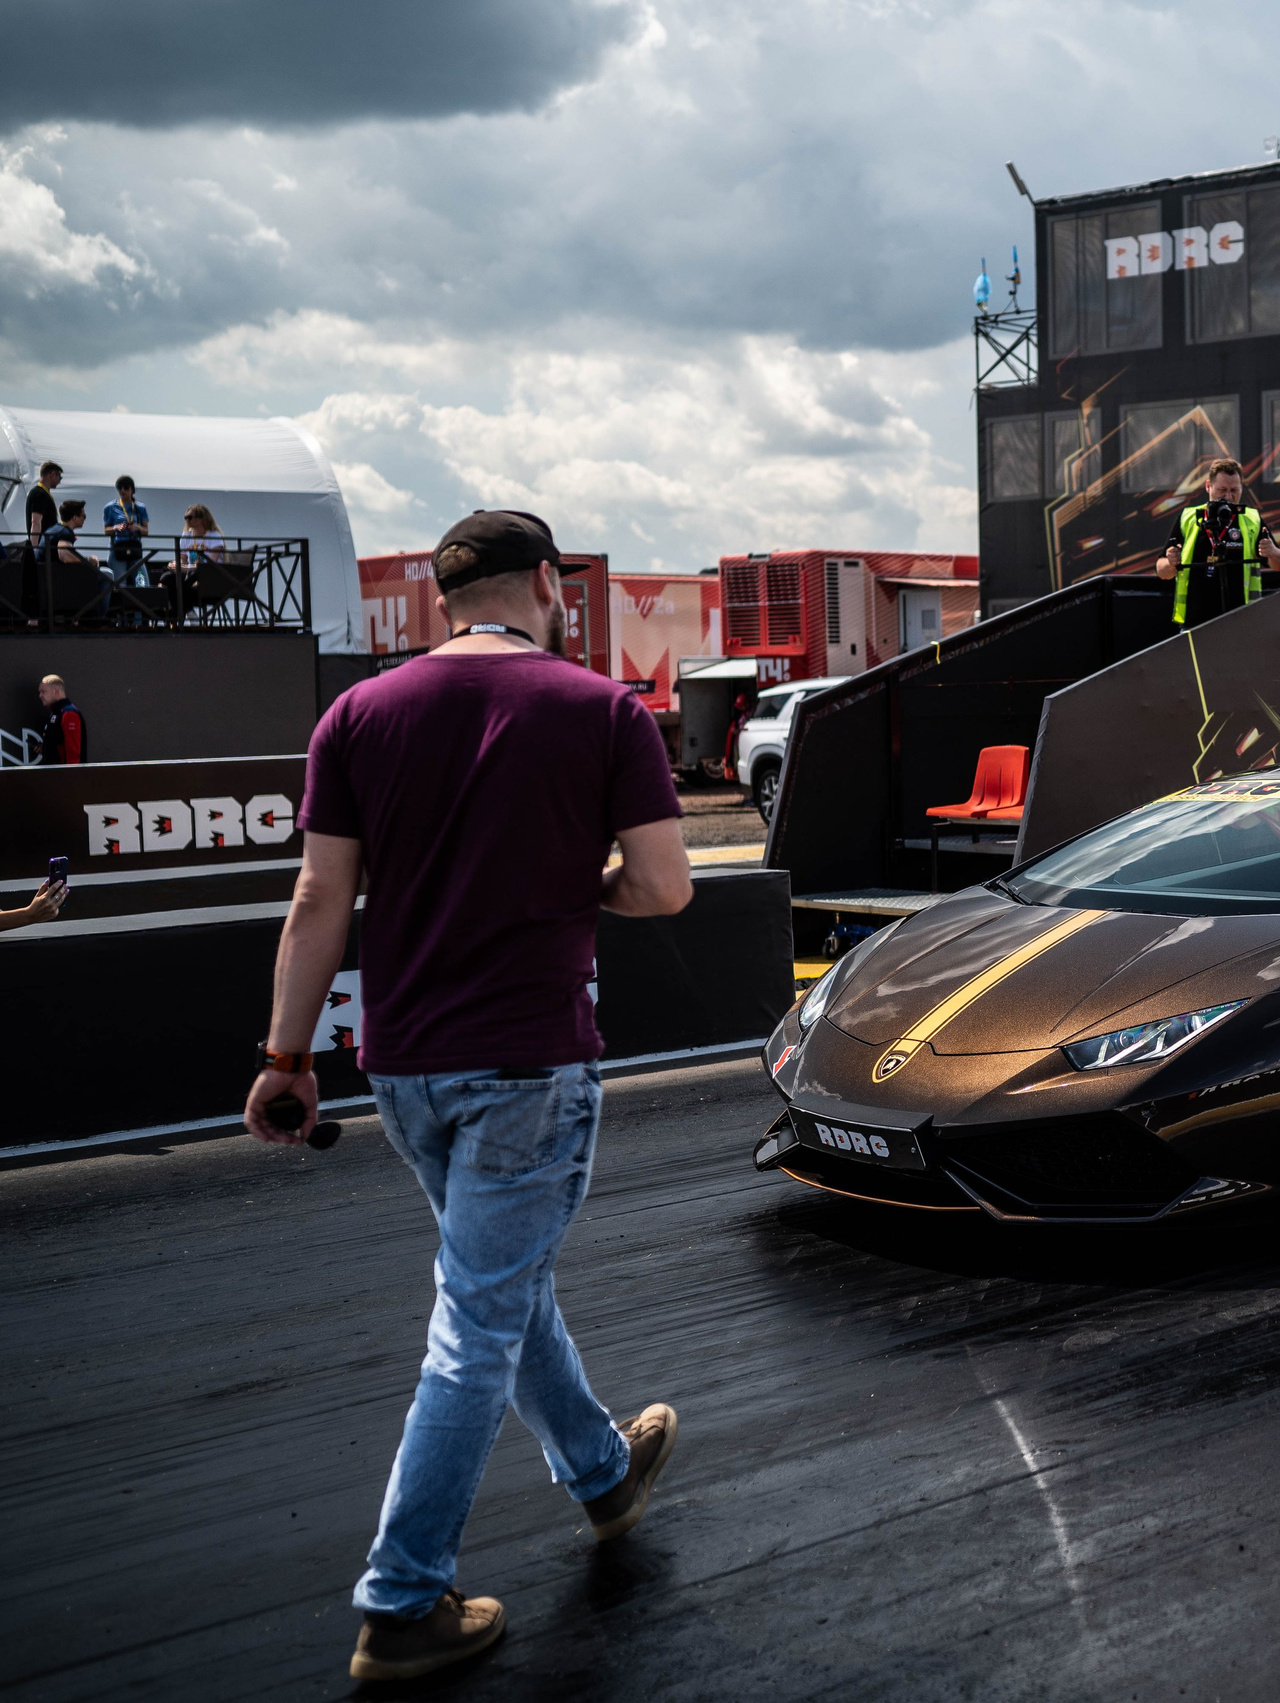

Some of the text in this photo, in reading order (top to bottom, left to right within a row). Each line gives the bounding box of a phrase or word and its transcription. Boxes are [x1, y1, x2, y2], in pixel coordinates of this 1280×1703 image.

[1104, 220, 1244, 280] RDRC
[83, 793, 294, 856] RDRC
[814, 1122, 890, 1158] RDRC
